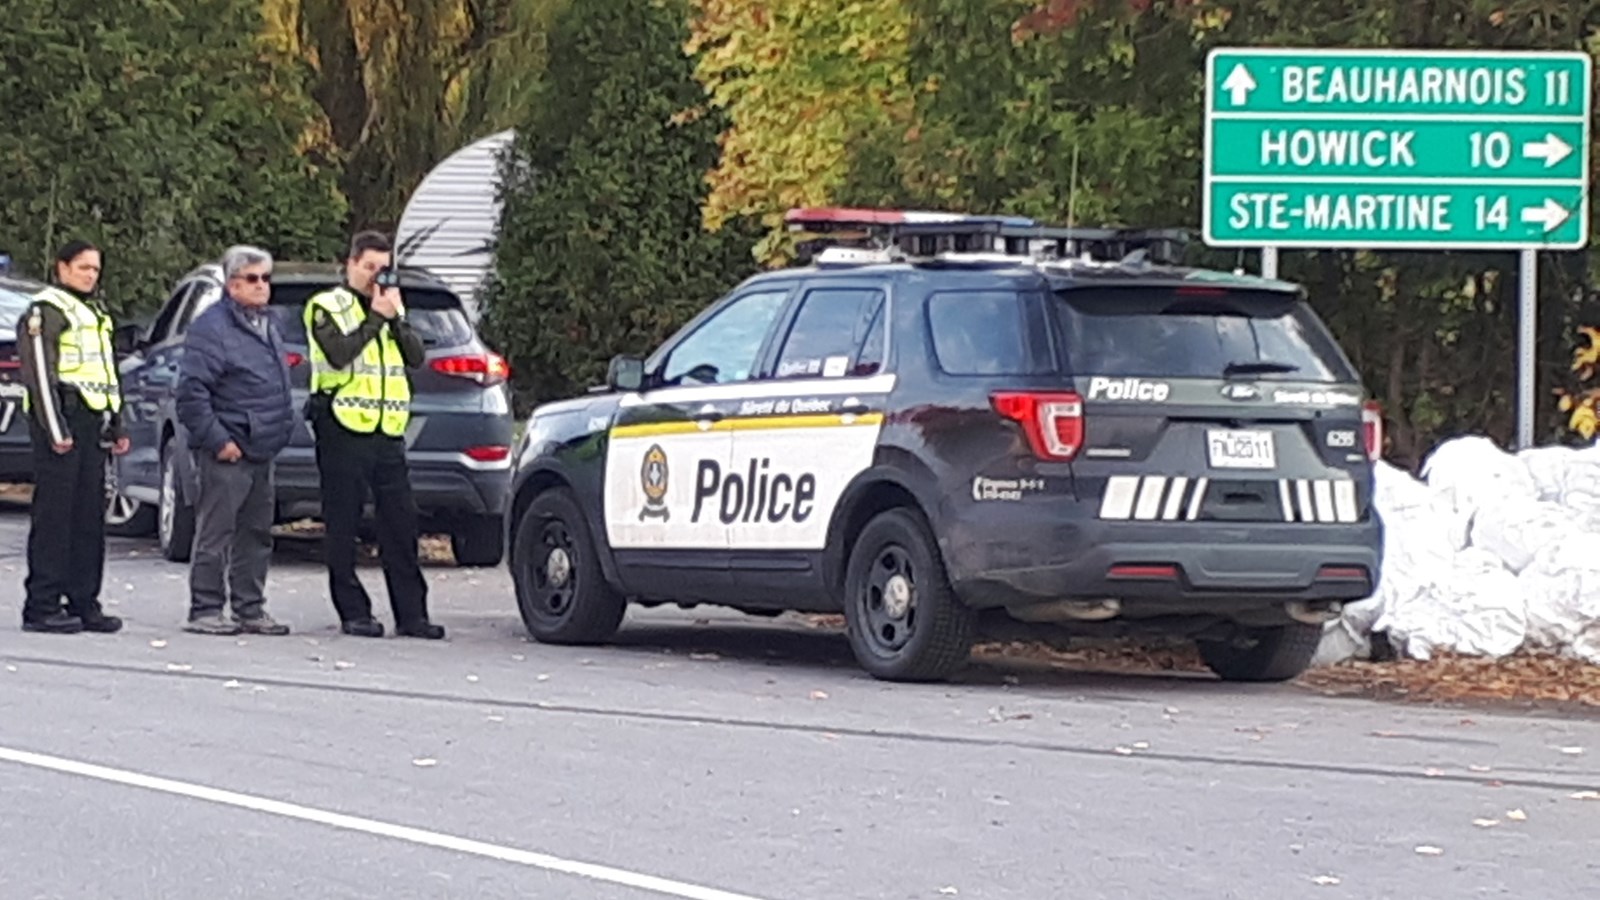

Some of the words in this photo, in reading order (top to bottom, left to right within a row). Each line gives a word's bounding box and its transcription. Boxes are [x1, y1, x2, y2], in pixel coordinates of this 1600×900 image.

[1281, 66, 1526, 105] BEAUHARNOIS
[1544, 70, 1570, 107] 11
[1260, 129, 1416, 168] HOWICK
[1469, 131, 1511, 168] 10
[1228, 192, 1453, 232] STE-MARTINE
[1474, 195, 1509, 232] 14
[1088, 377, 1169, 401] Police
[690, 457, 816, 525] Police
